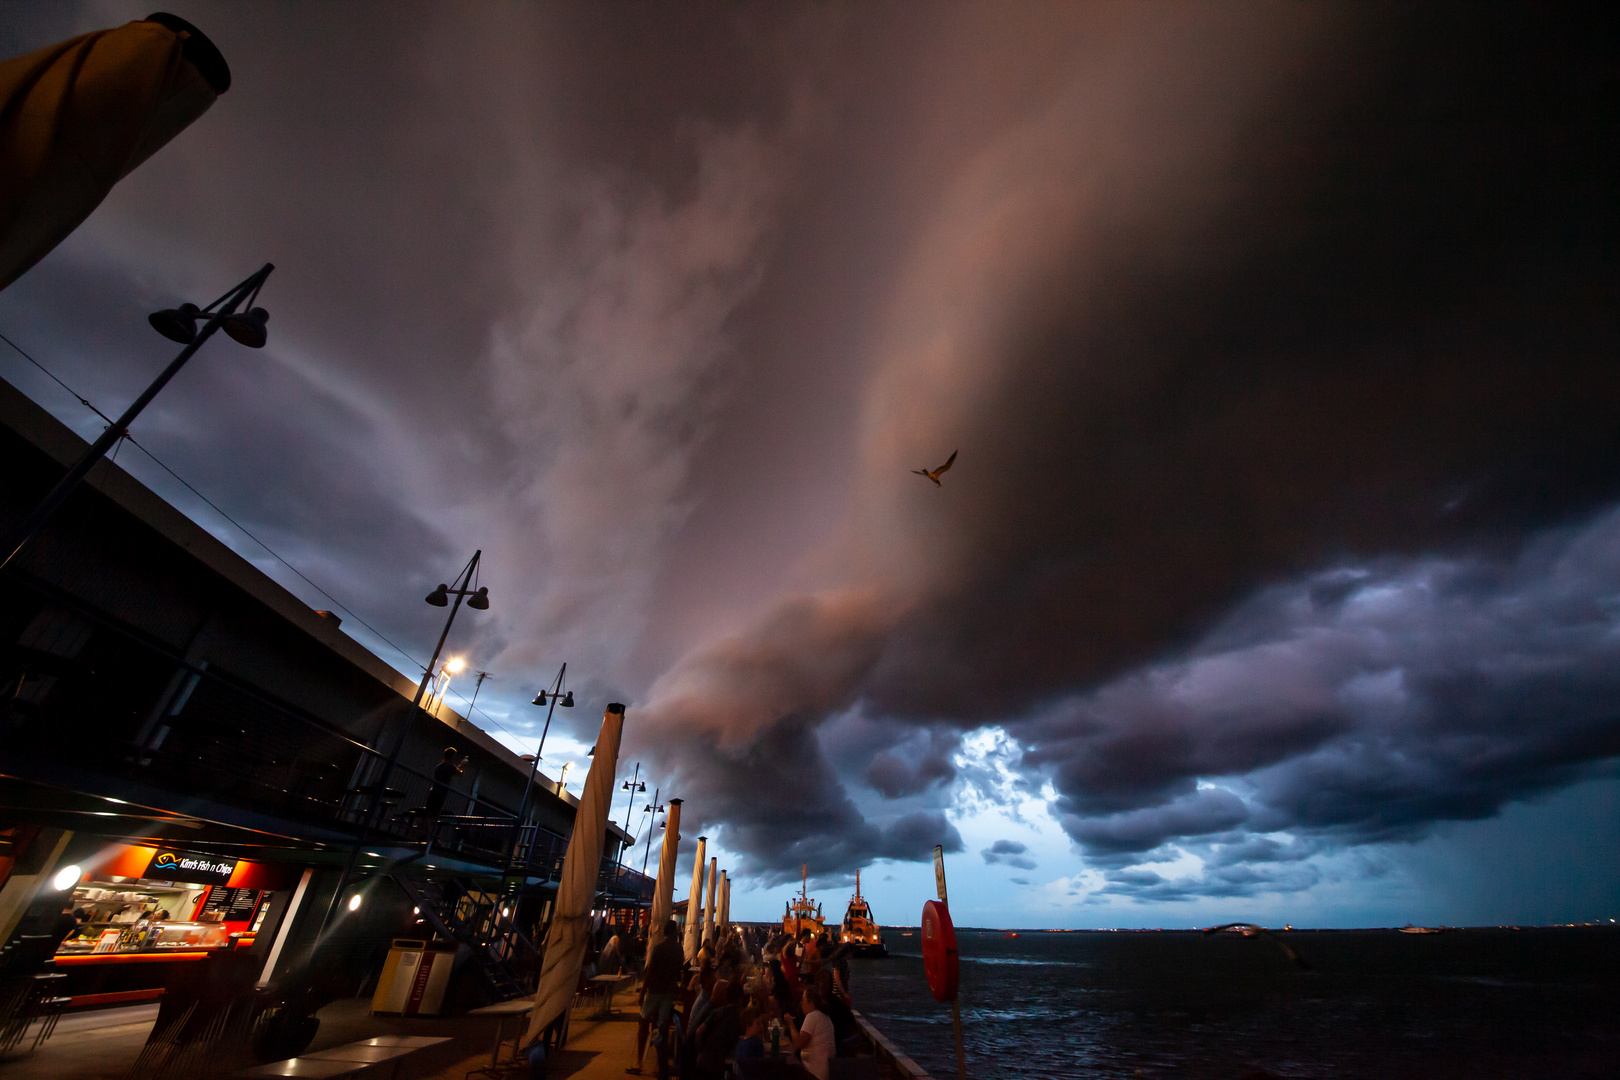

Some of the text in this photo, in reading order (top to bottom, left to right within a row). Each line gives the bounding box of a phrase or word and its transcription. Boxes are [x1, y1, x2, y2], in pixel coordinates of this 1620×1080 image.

[179, 858, 234, 876] Kim's Fish n Chips
[411, 965, 430, 1001] Landfill
